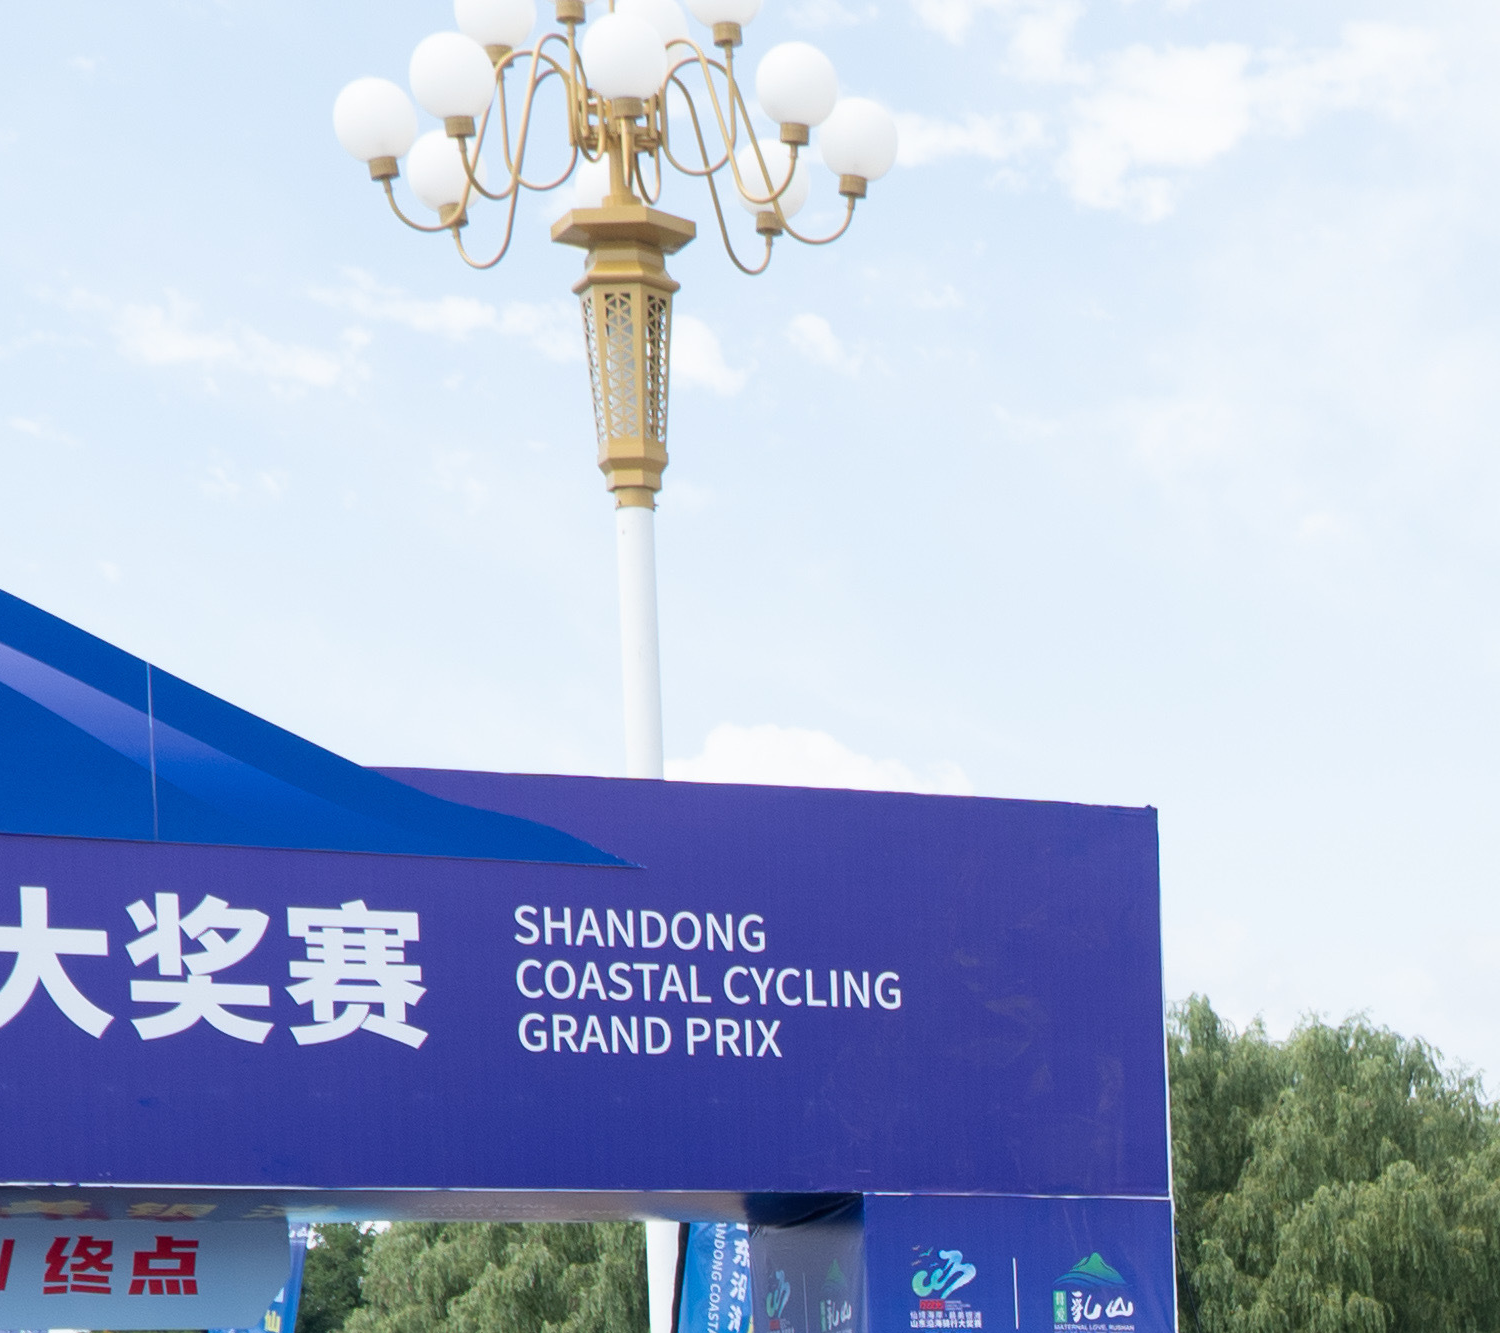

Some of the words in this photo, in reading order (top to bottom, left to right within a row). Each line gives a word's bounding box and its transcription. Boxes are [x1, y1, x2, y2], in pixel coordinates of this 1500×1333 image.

[513, 904, 767, 953] SHANDONG
[515, 958, 712, 1004] COASTAL
[723, 964, 902, 1010] CYCLING
[517, 1012, 672, 1056] GRAND
[686, 1018, 783, 1058] PRIX
[710, 1222, 728, 1281] ANDONG
[1071, 1290, 1134, 1323] 乳山
